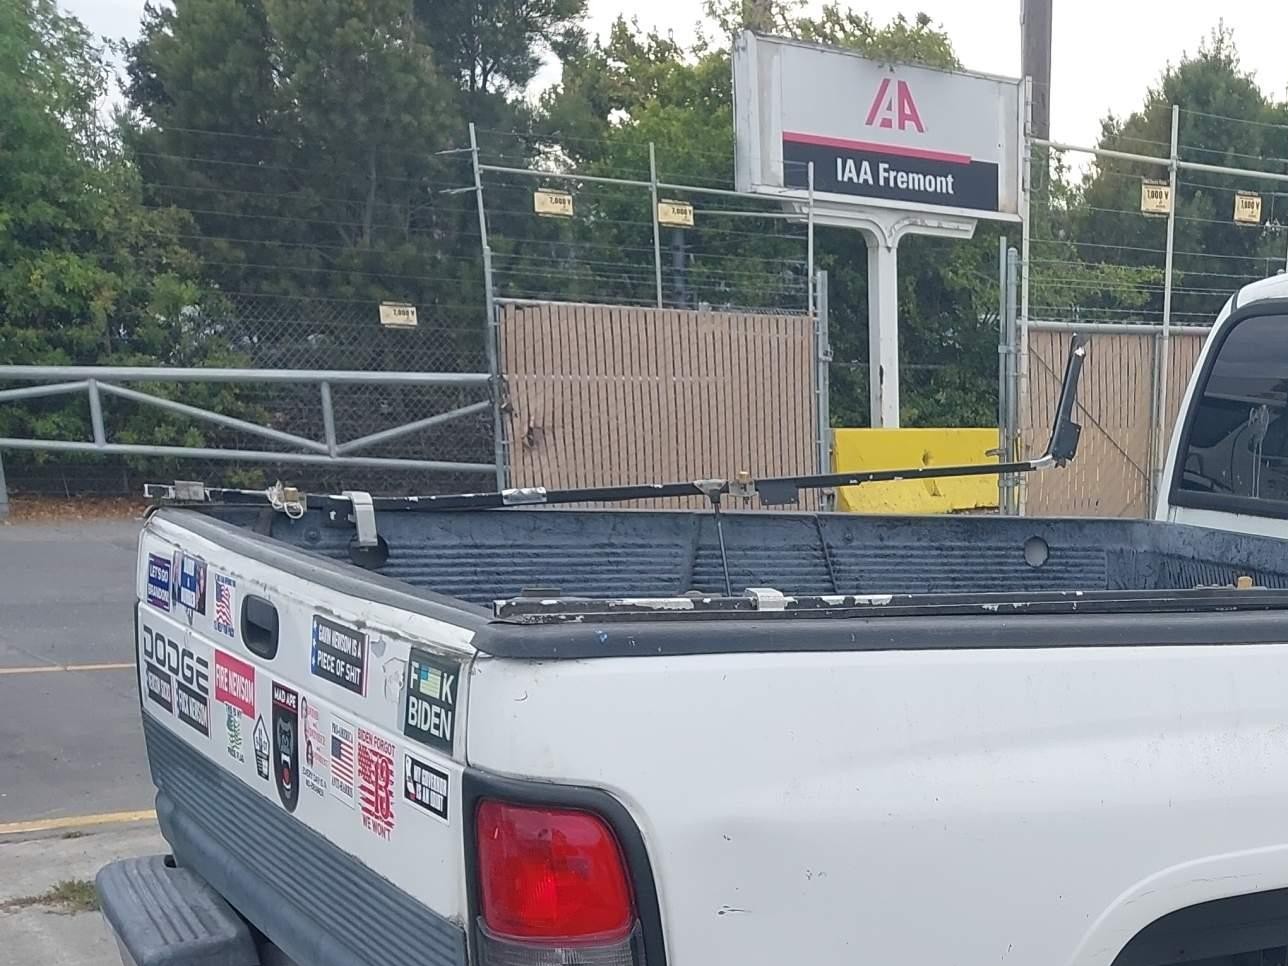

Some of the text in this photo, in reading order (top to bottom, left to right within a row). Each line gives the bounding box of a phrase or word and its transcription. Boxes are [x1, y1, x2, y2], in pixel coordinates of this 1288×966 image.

[836, 157, 954, 194] IAA Fremont
[143, 623, 209, 697] DODGE
[332, 630, 351, 655] NEWSOM
[352, 639, 358, 657] IS
[357, 641, 361, 660] A
[215, 663, 254, 706] FIRE NEWSOM
[317, 650, 361, 686] PIECE OF SHIT
[273, 687, 297, 709] MAD APE
[408, 695, 452, 741] BIDEN
[358, 727, 396, 758] BIDEN FORGOT
[375, 756, 391, 820] 13
[362, 815, 391, 841] WE WON'T
